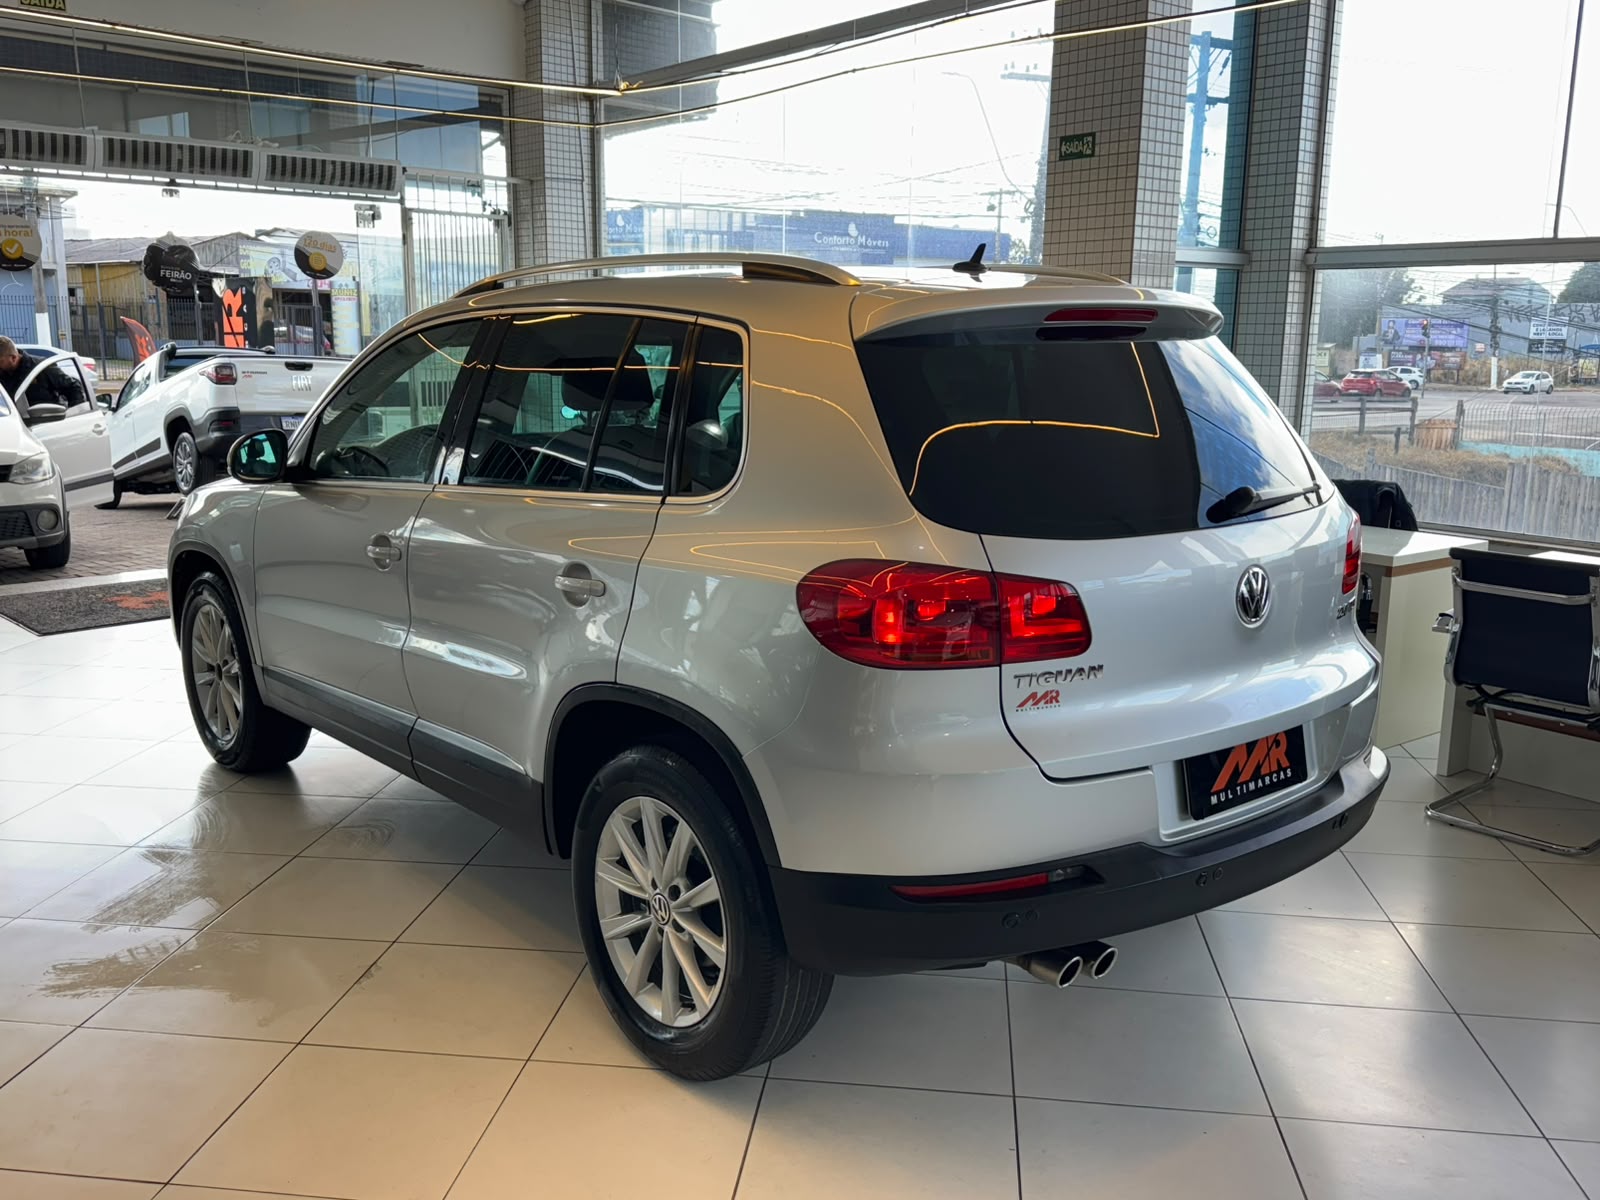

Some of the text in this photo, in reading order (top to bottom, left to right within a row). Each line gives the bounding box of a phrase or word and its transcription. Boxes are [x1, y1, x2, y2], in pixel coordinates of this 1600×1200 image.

[814, 231, 855, 245] Conforto
[160, 269, 192, 280] FEIRÃO
[292, 375, 312, 391] FIAT
[1014, 664, 1104, 688] TIGUAN
[1210, 768, 1292, 805] MULTIMARCAS
